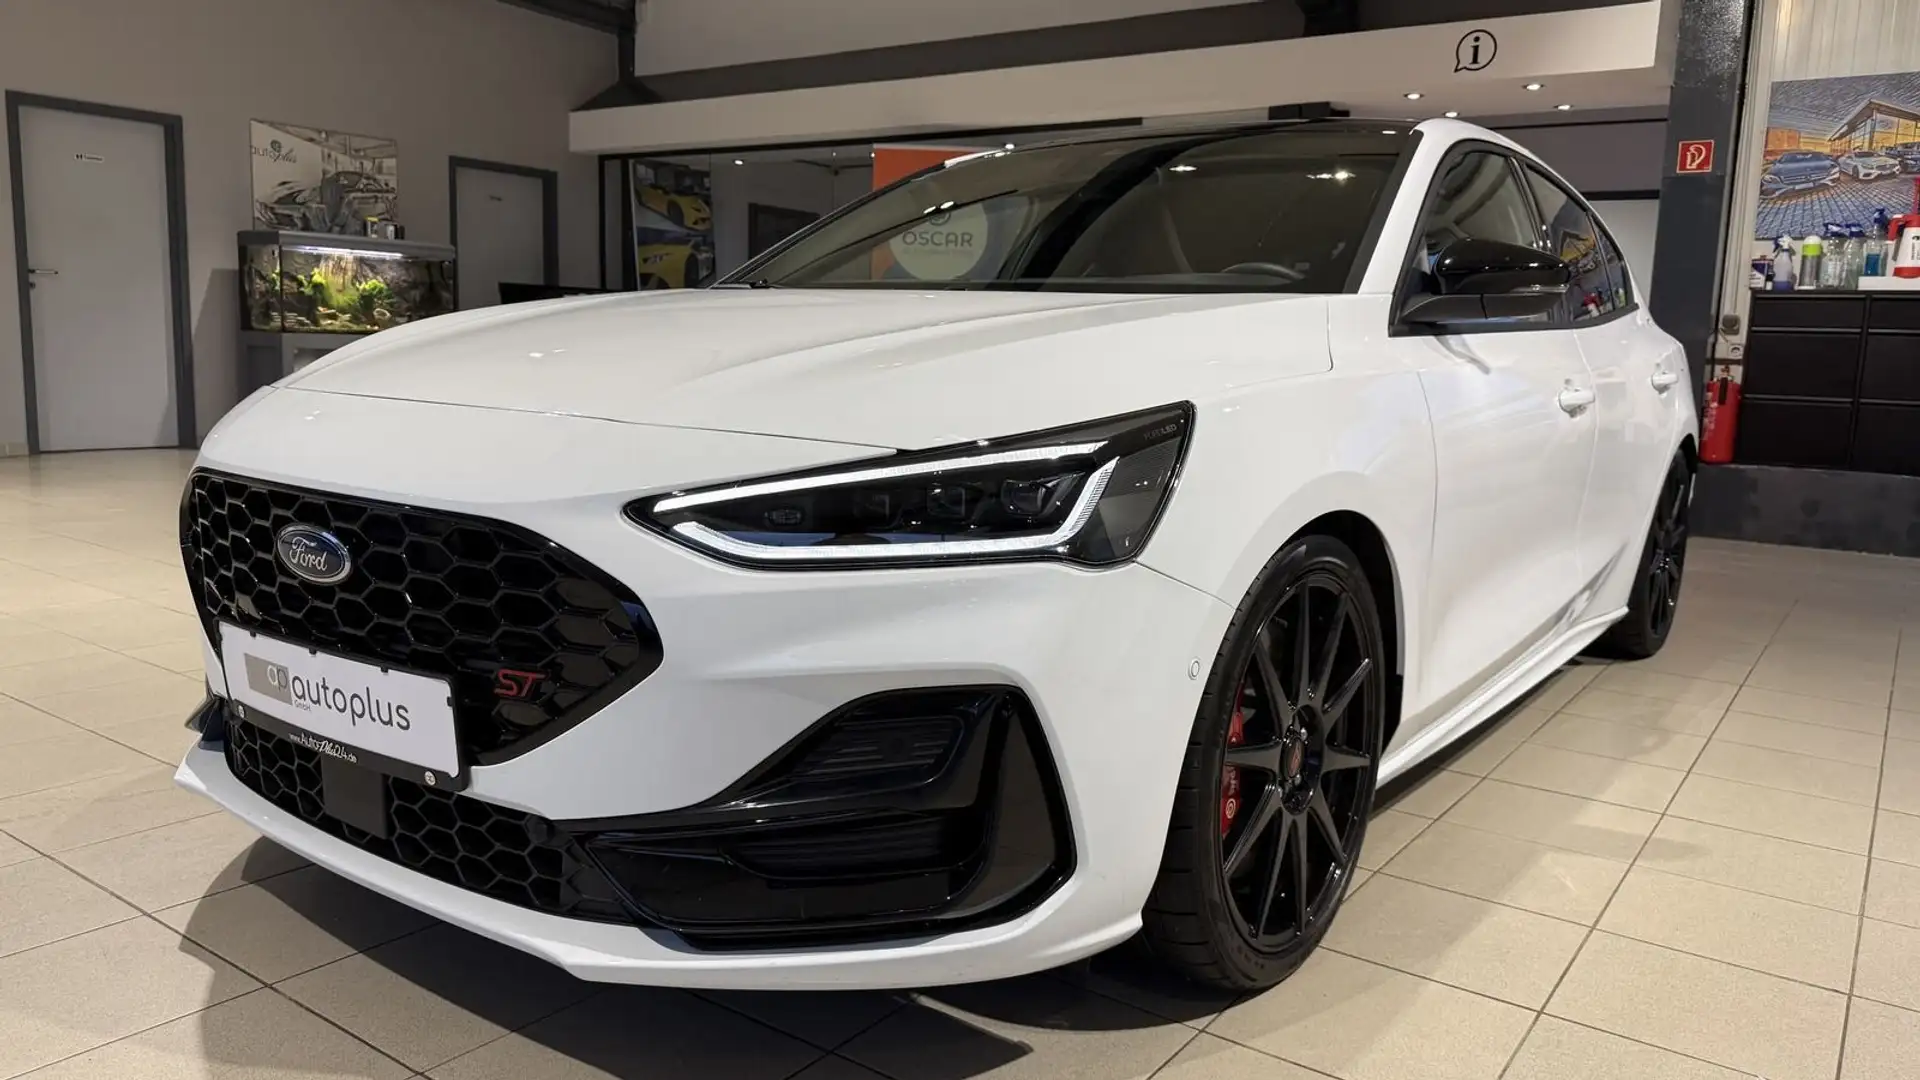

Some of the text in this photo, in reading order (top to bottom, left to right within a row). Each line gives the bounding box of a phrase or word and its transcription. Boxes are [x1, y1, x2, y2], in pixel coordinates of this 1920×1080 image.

[902, 231, 974, 248] OSCAR
[289, 536, 328, 571] Ford
[494, 669, 546, 697] ST
[292, 675, 411, 731] autoplus
